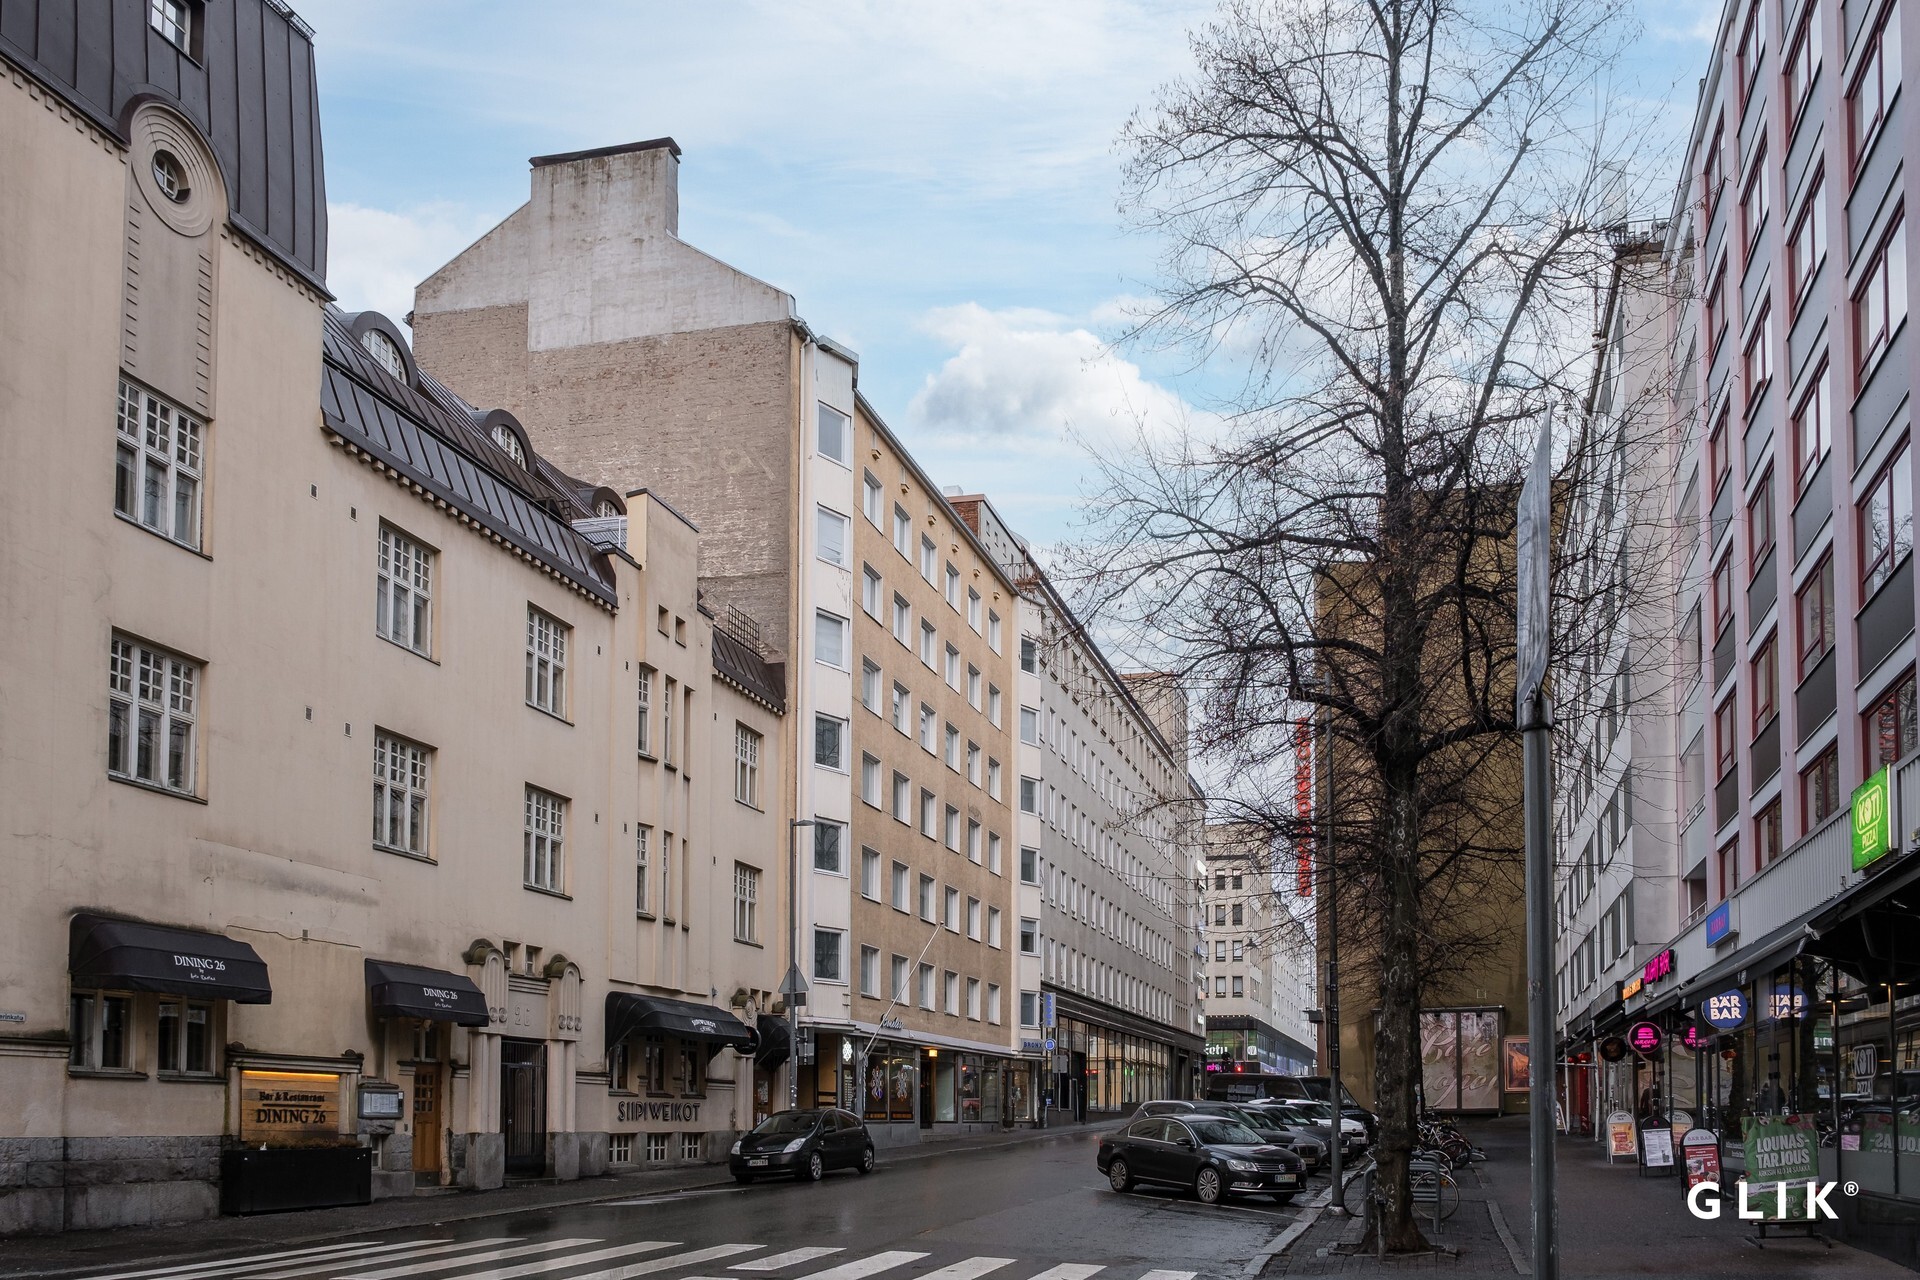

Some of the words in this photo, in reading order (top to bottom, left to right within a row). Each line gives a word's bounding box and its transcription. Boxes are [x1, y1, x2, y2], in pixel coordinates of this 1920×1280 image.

[1859, 790, 1880, 829] KOTI
[173, 955, 214, 970] DINING
[214, 960, 226, 971] 26
[423, 987, 450, 999] DINING
[450, 991, 458, 1000] 26
[1709, 995, 1742, 1009] BÄR
[1710, 1007, 1743, 1021] BAR
[1853, 1048, 1874, 1076] KOTI
[258, 1091, 275, 1101] Bar
[275, 1091, 283, 1102] &
[283, 1091, 326, 1103] Restaurant
[256, 1108, 309, 1124] DINING
[312, 1109, 327, 1124] 26
[617, 1101, 701, 1122] SIIPIWEIKOT
[1756, 1133, 1810, 1153] LOUNAS-
[1756, 1149, 1810, 1169] TARJOUS
